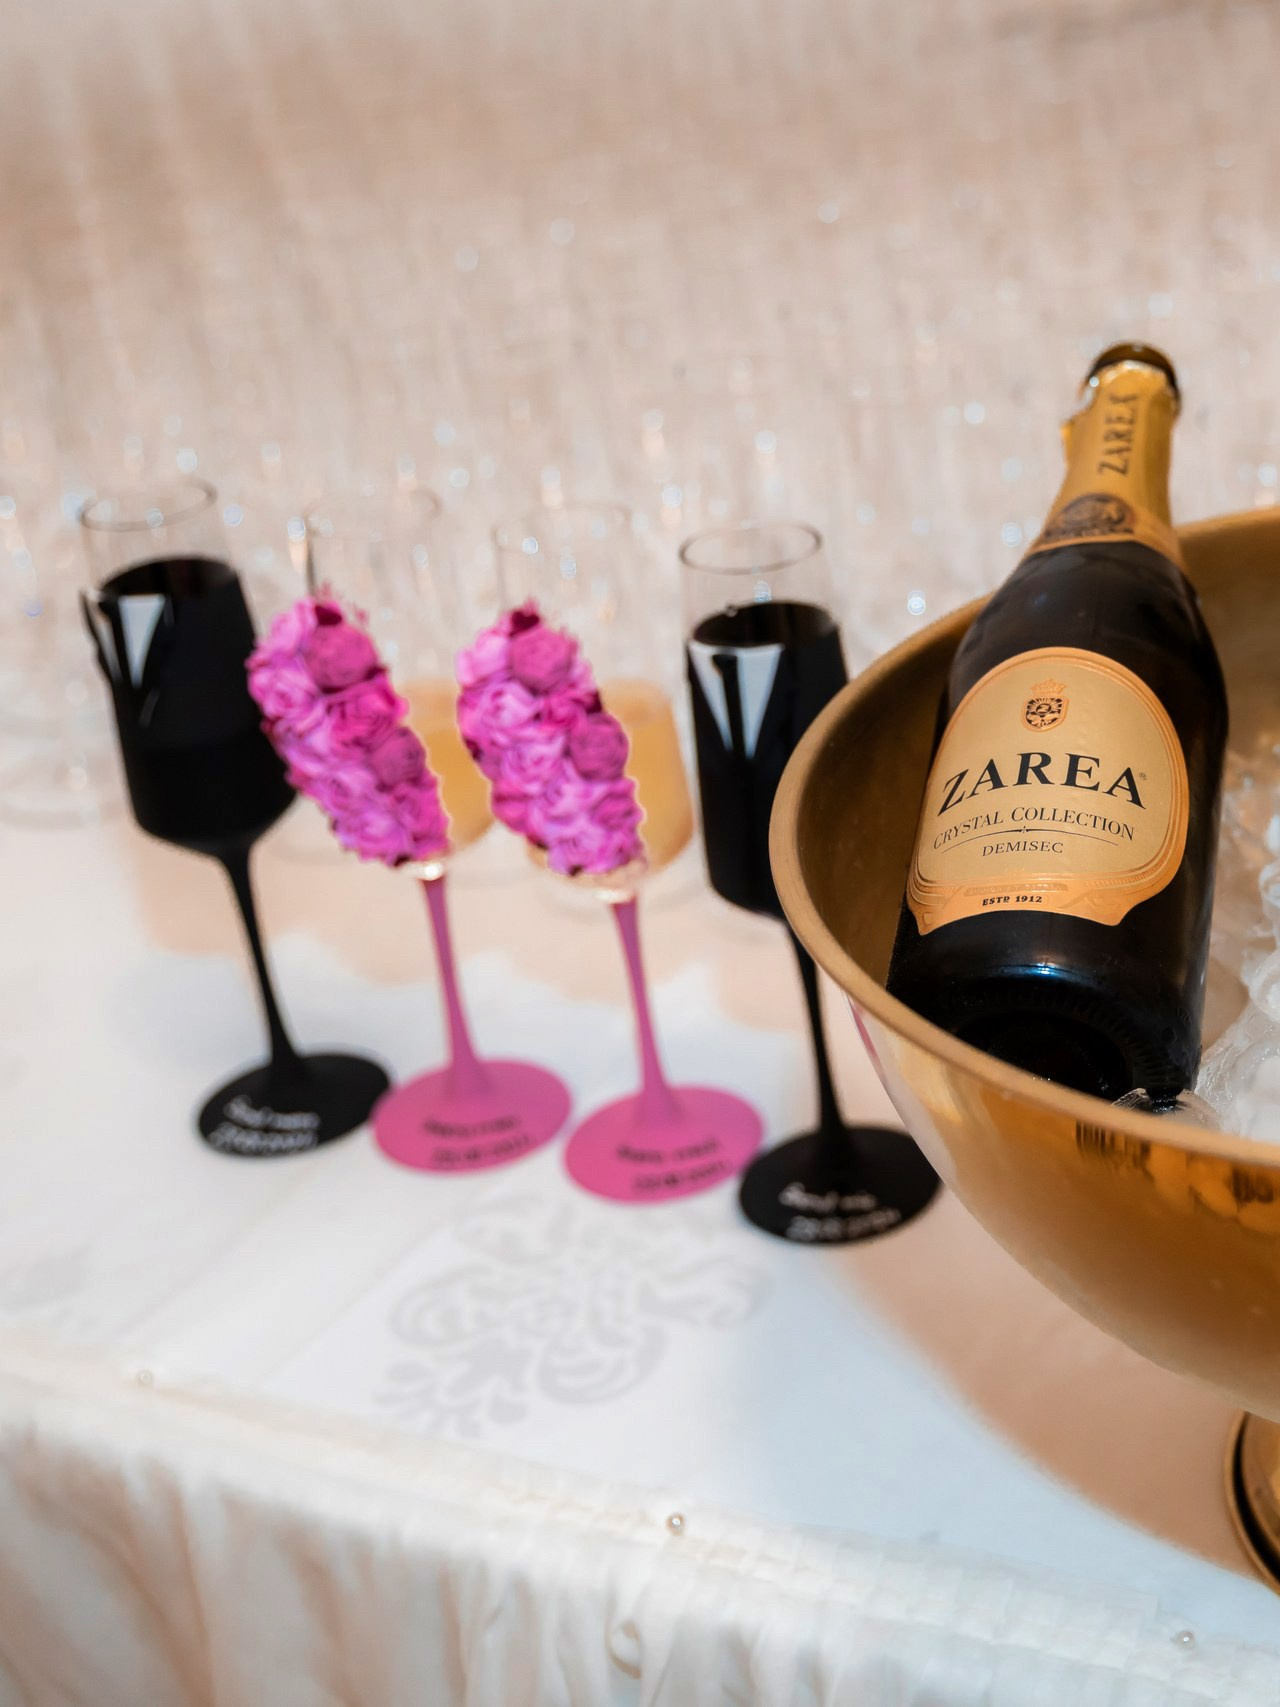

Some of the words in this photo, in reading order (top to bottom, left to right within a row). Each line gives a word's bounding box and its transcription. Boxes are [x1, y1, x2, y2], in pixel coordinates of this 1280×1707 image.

[933, 811, 1003, 849] CRYSTAL
[1011, 806, 1135, 841] COLLECTION
[981, 840, 1064, 857] DEMISEC
[1015, 895, 1043, 903] 1912
